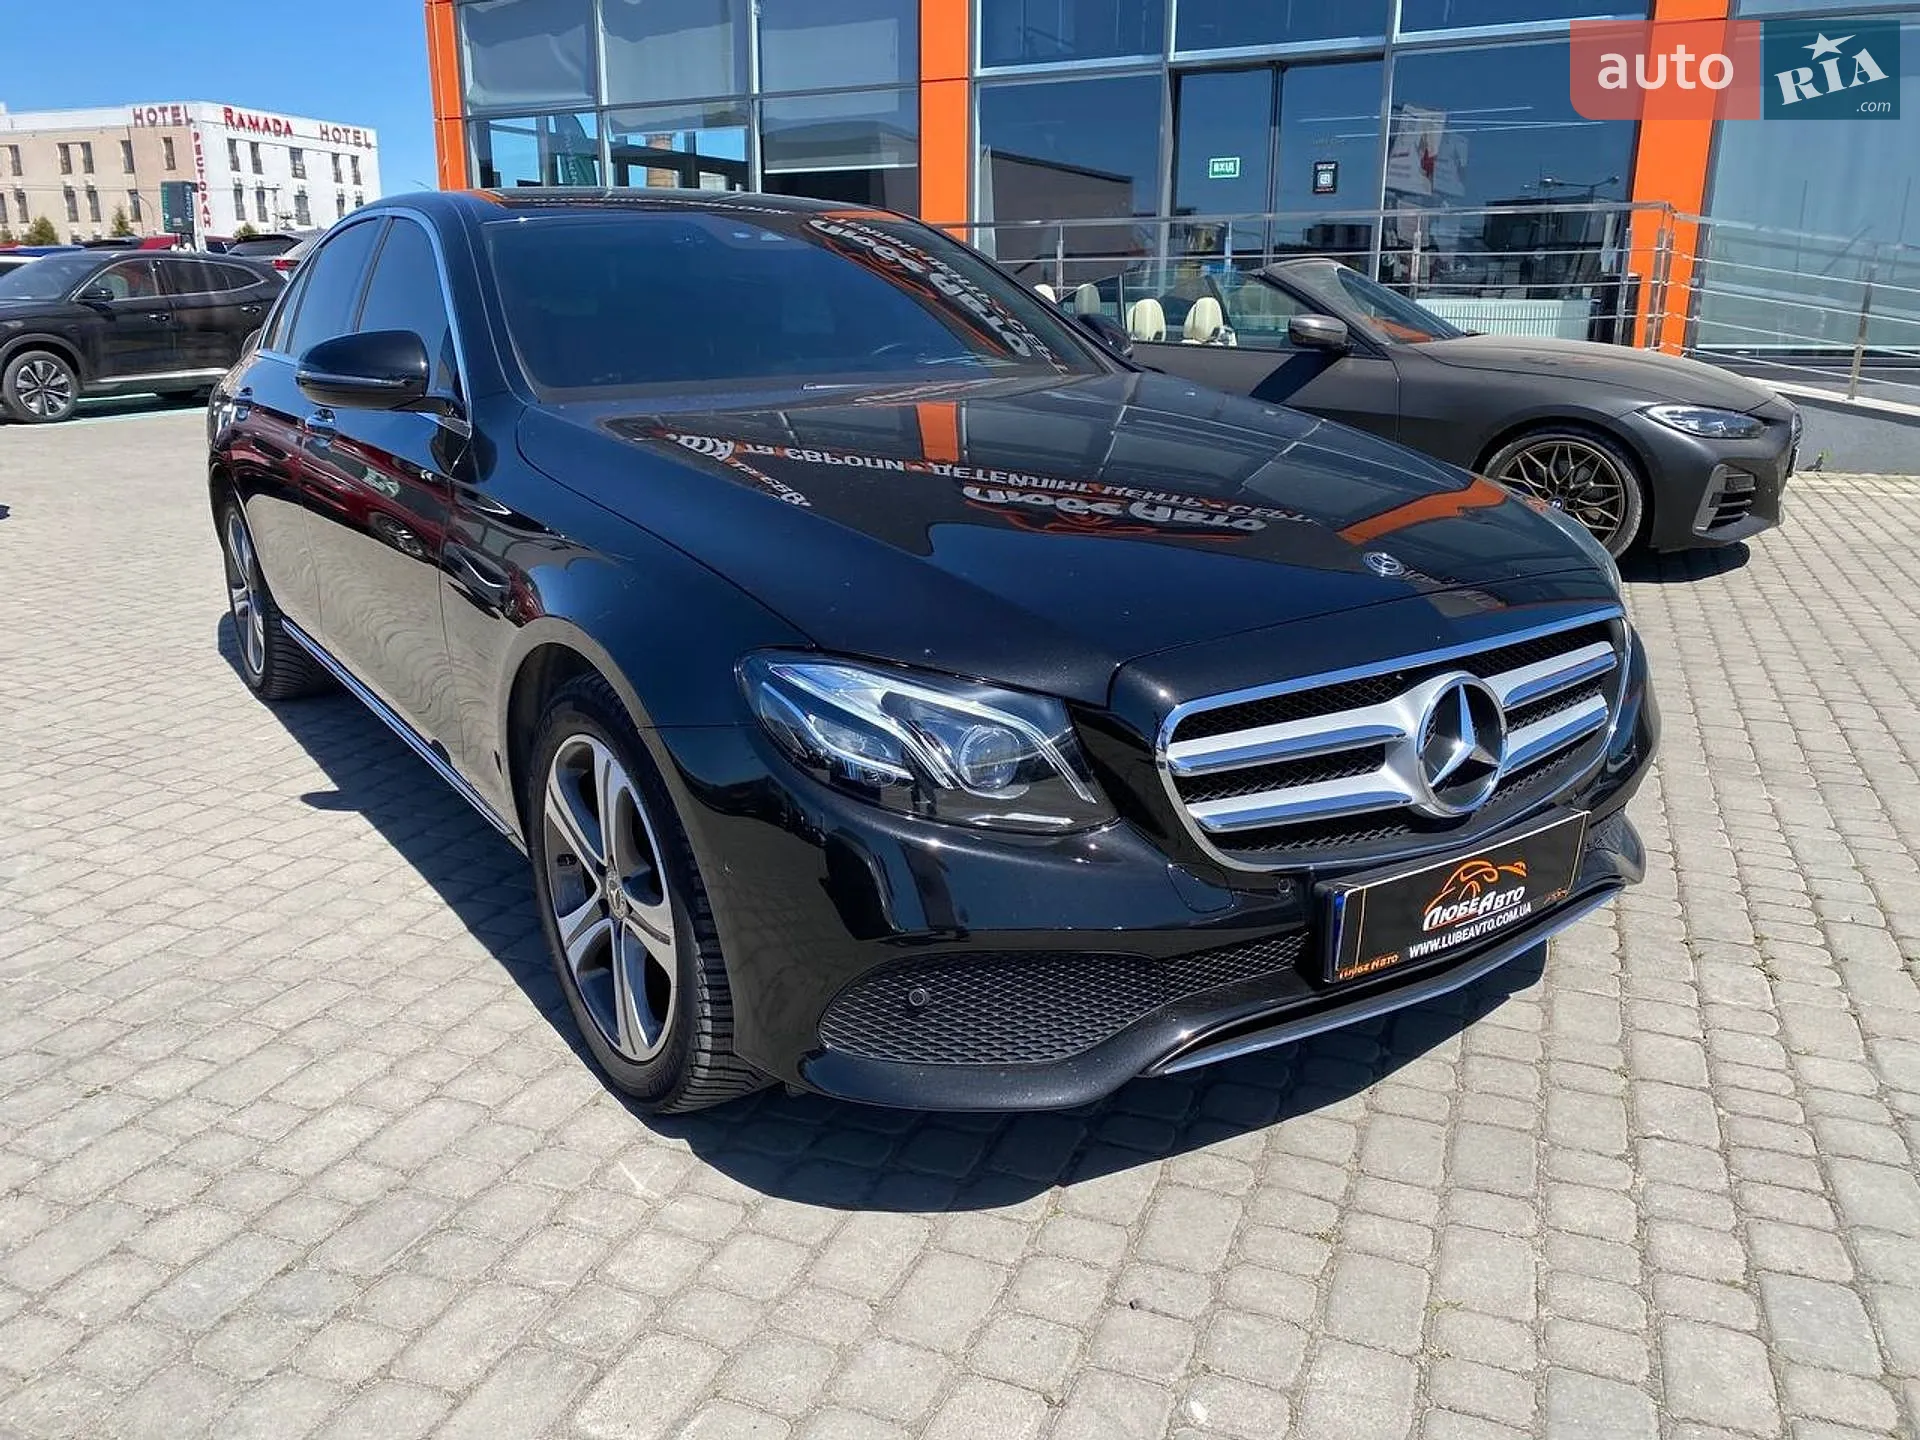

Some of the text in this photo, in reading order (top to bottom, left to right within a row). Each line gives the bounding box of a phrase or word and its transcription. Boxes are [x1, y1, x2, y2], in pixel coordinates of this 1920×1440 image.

[132, 105, 193, 127] HOTEL
[319, 124, 372, 149] HOTEL
[193, 132, 212, 229] РЕСТОРАН
[1409, 901, 1532, 959] WWW.LUBEAVTO.COM.UA
